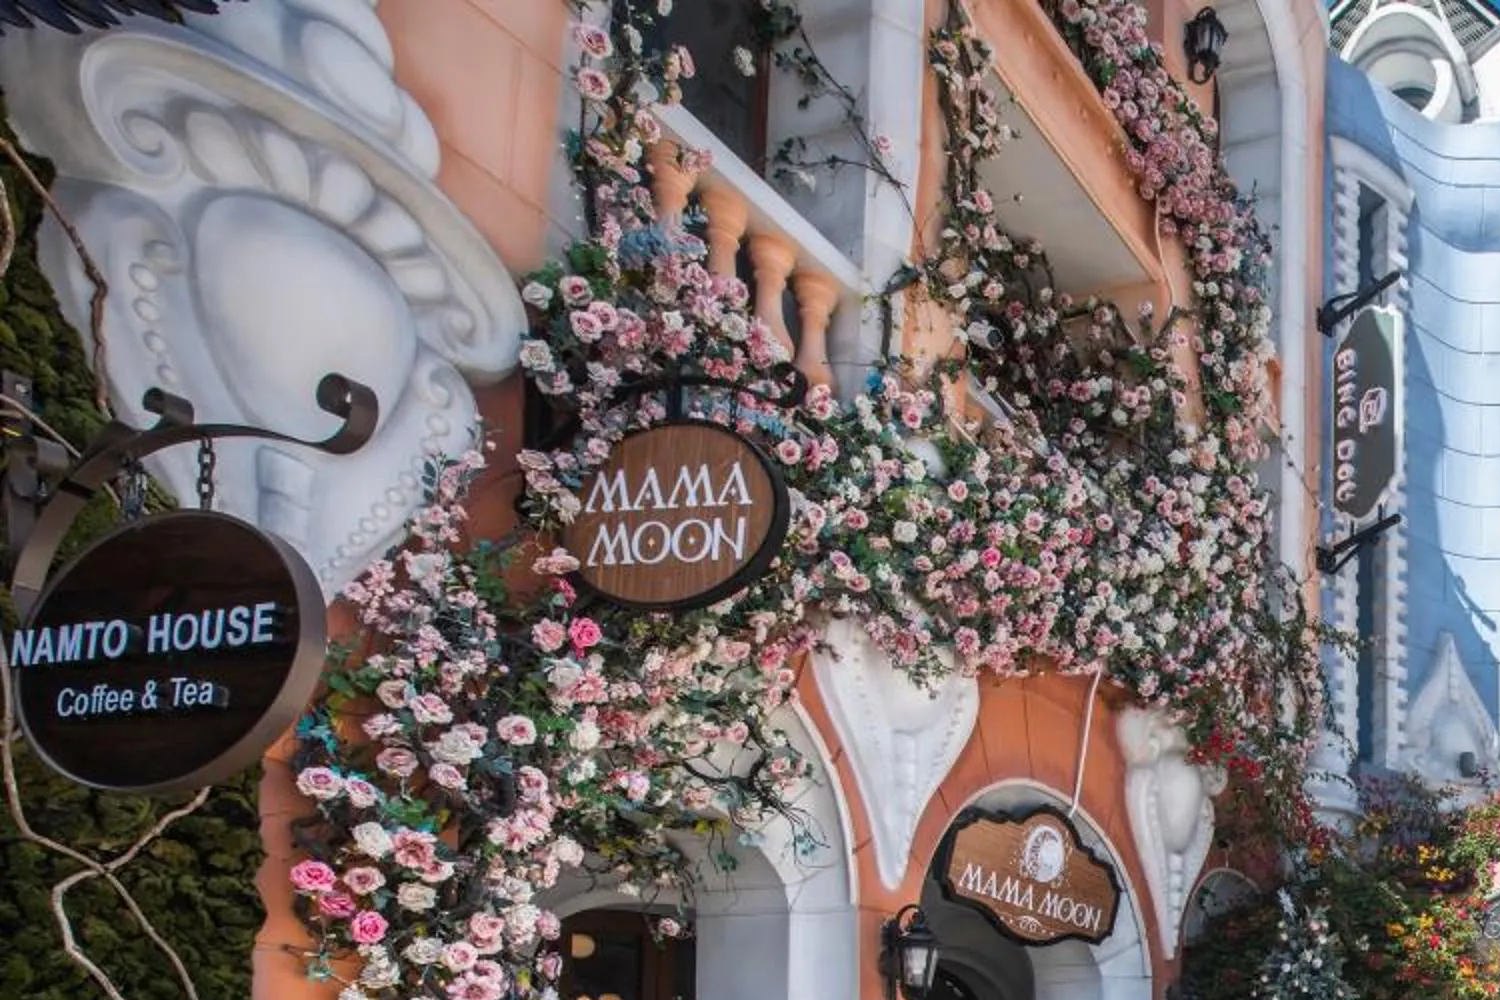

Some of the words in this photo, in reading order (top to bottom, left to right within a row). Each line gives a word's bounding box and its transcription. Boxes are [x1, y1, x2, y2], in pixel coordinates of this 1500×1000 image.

[1336, 348, 1357, 428] BING
[585, 461, 753, 513] MAMA
[1335, 439, 1357, 502] DOU
[587, 516, 747, 567] MOON
[11, 619, 129, 667] NAMTO
[147, 601, 276, 653] HOUSE
[57, 684, 134, 717] Coffee
[141, 679, 157, 709] &
[169, 677, 214, 708] Tea
[959, 862, 1034, 911] MAMA
[1037, 890, 1102, 933] MOON
